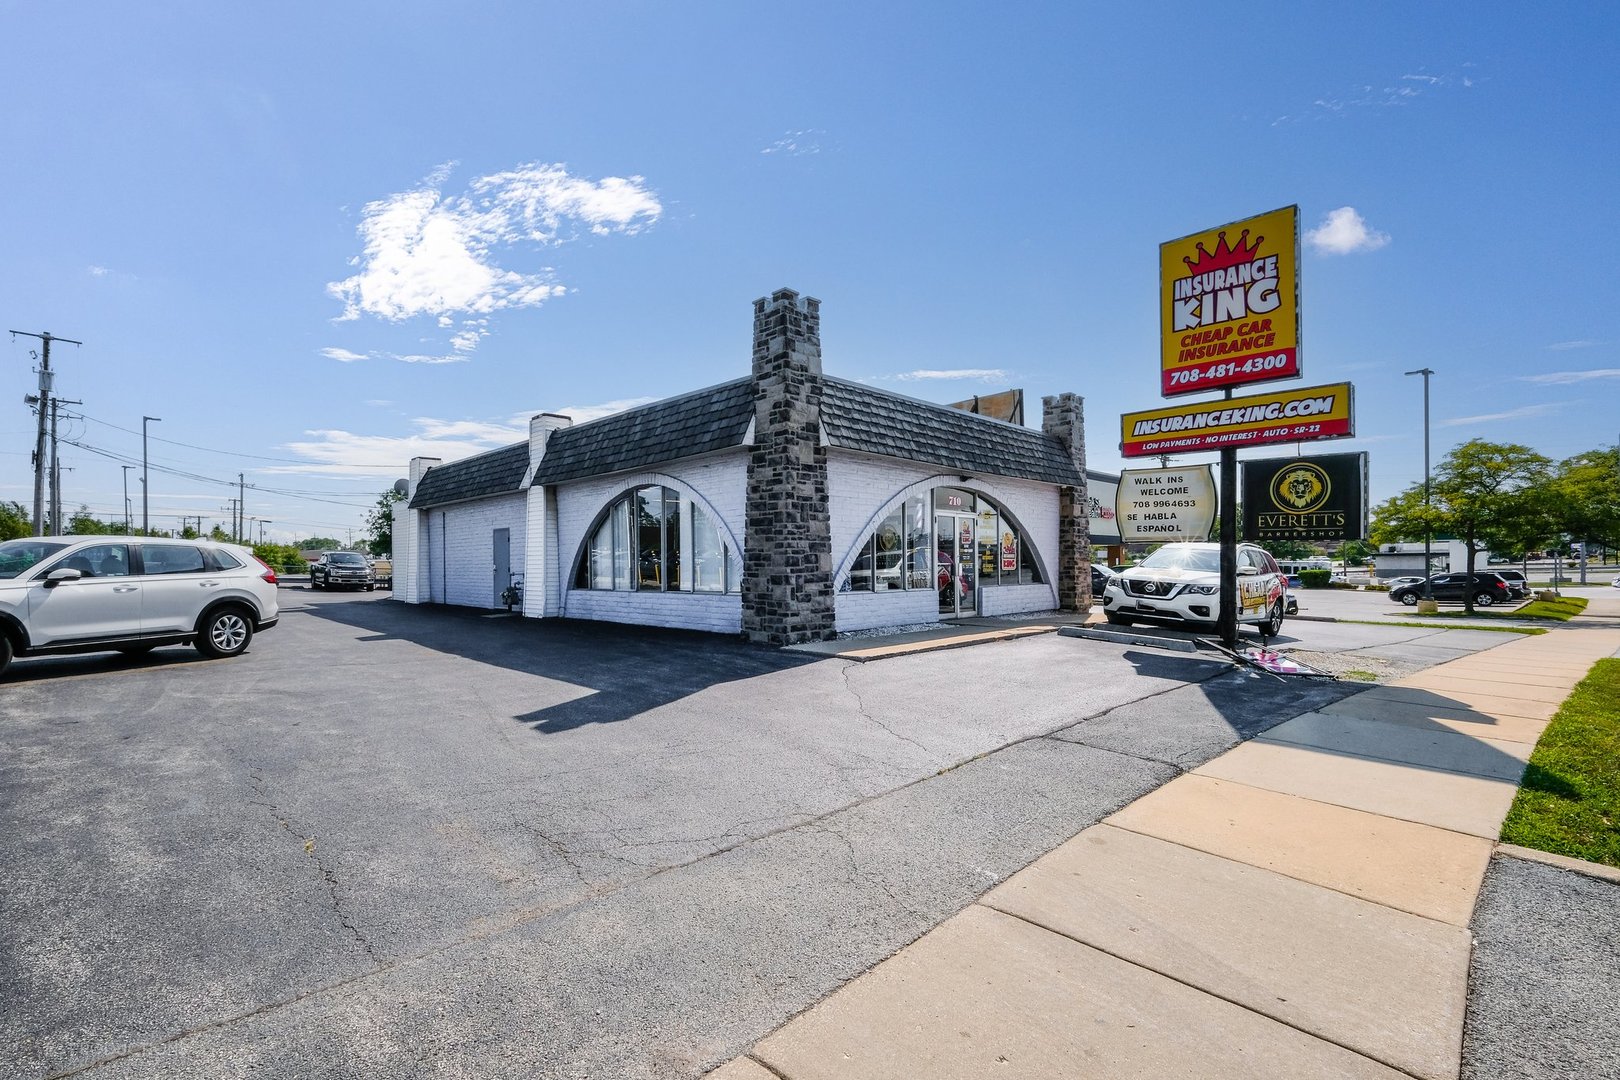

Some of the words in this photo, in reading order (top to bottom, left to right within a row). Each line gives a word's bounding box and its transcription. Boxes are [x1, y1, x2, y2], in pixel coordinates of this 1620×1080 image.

[1174, 255, 1278, 301] INSURANCE
[1173, 277, 1281, 332] KING
[1181, 326, 1233, 348] CHEAP
[1237, 319, 1272, 336] CAR
[1178, 333, 1276, 363] INSURANCE
[1170, 354, 1287, 385] 708-481-4300
[1132, 395, 1335, 437] INSURANCEKING.COM
[1142, 442, 1159, 450] LOW
[1160, 437, 1201, 449] PAYMENTS
[1205, 433, 1218, 443] NO
[1219, 431, 1257, 442] INTEREST
[1263, 427, 1289, 437] AUTO
[1293, 424, 1320, 434] SR-22
[1134, 477, 1162, 485] WALK
[1167, 476, 1183, 484] INS
[948, 496, 961, 506] 710
[1140, 487, 1189, 496] WELCOME
[1153, 500, 1196, 508] 9964693
[1144, 512, 1177, 521] HABLA
[1258, 513, 1345, 527] EVERETT'S
[1136, 524, 1182, 533] ESPAÑOL
